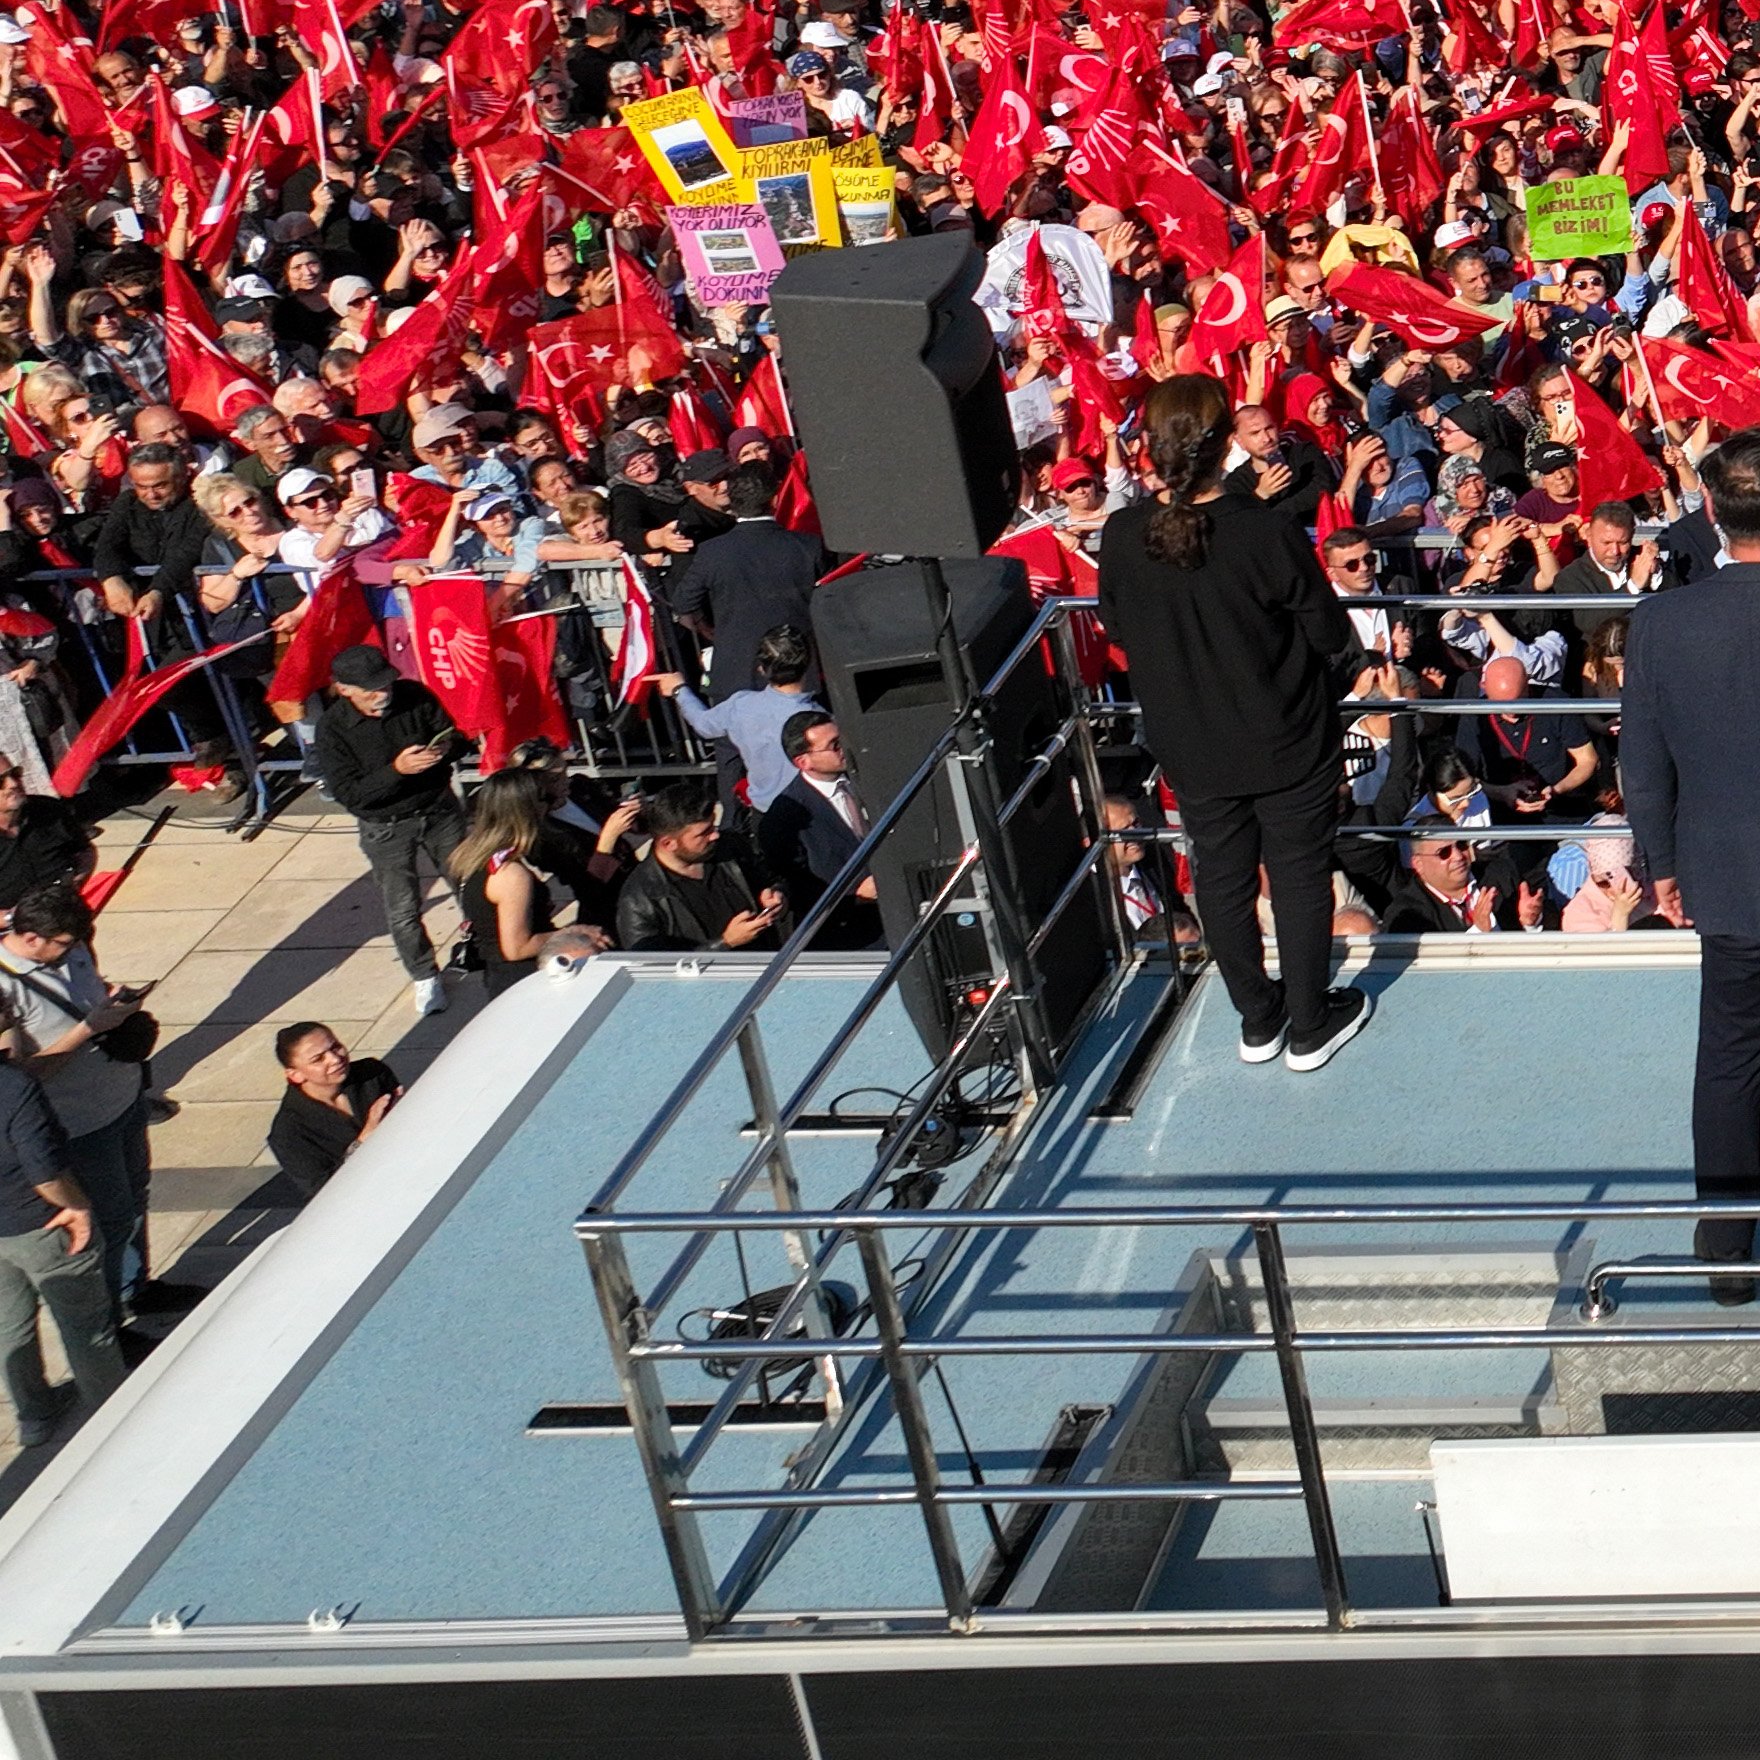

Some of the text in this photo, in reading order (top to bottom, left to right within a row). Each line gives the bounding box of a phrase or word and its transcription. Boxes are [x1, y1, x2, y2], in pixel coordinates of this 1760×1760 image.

[1555, 181, 1580, 195] BU
[1537, 193, 1616, 215] MEMLEKET
[426, 607, 455, 690] CHP
